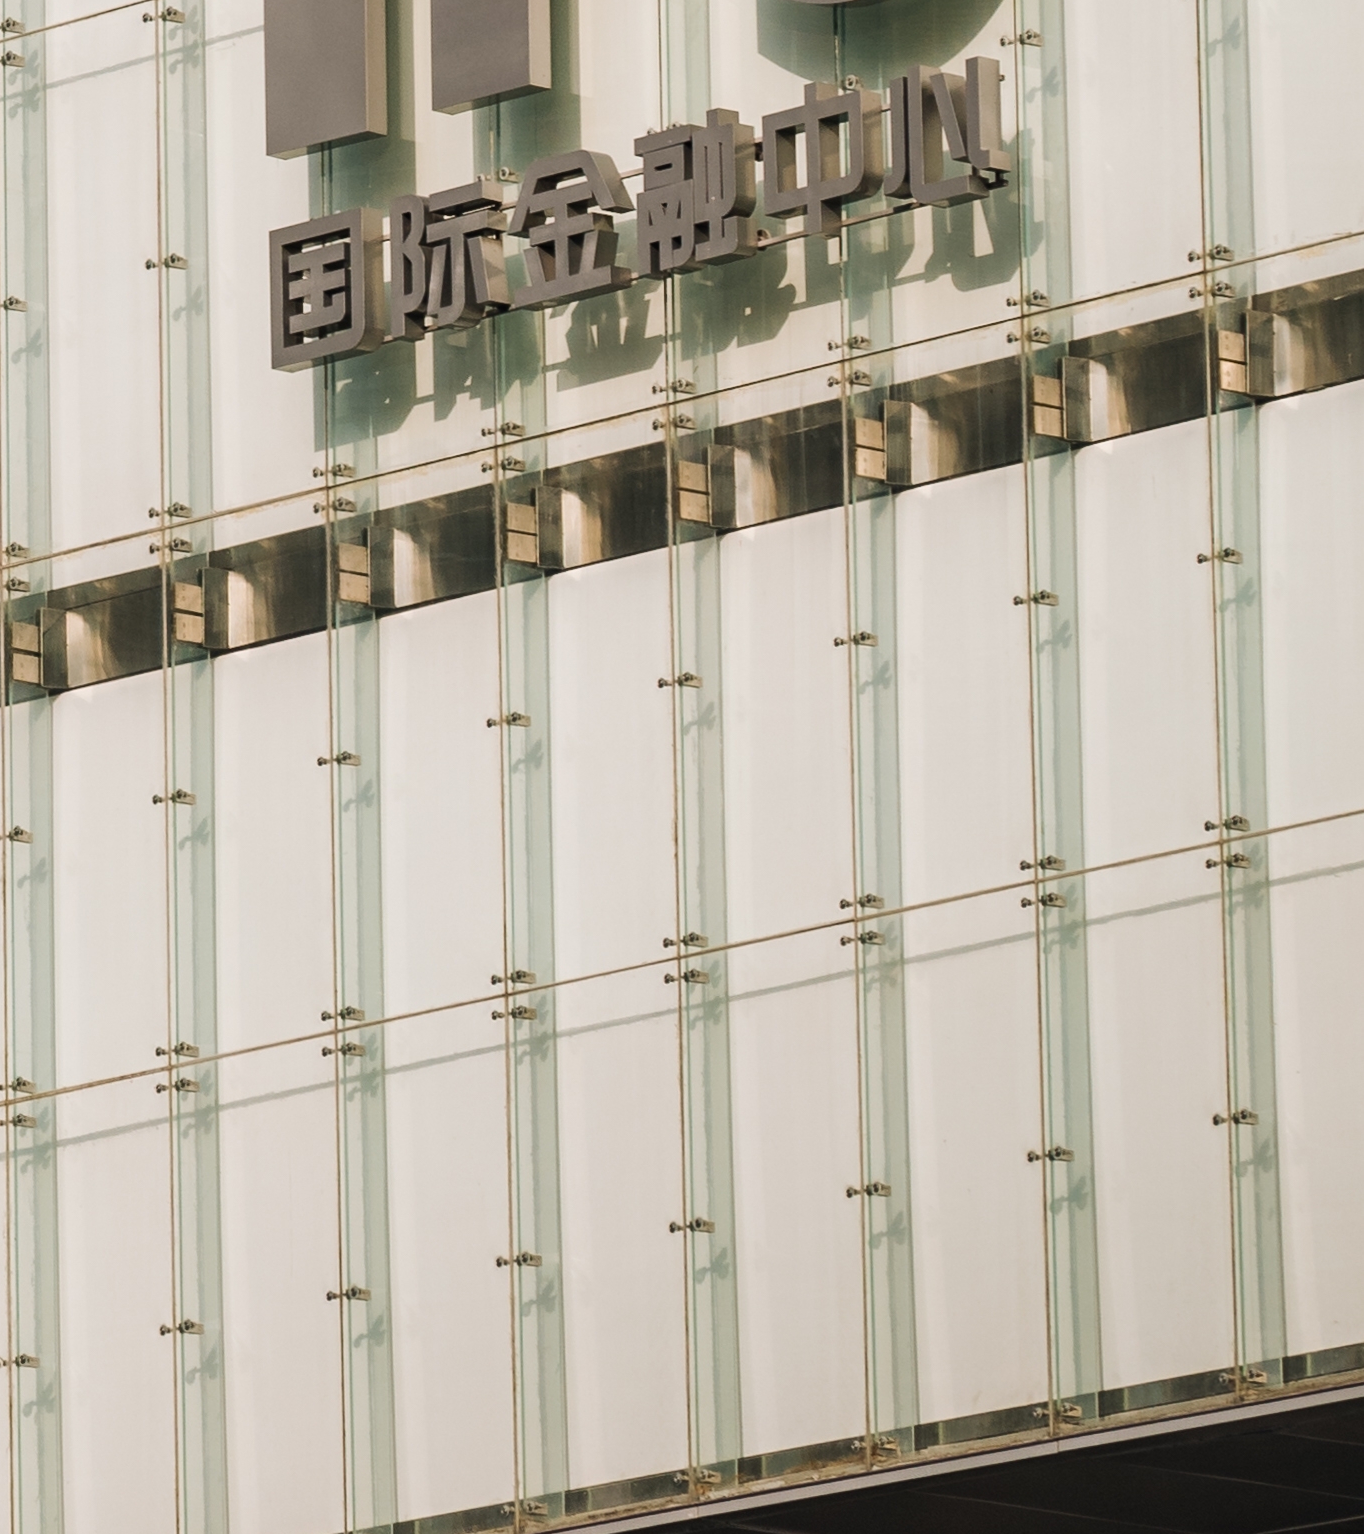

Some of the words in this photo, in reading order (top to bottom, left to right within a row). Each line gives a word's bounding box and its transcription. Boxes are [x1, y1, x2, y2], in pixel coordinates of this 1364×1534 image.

[269, 57, 1010, 371] 国际金融中心
